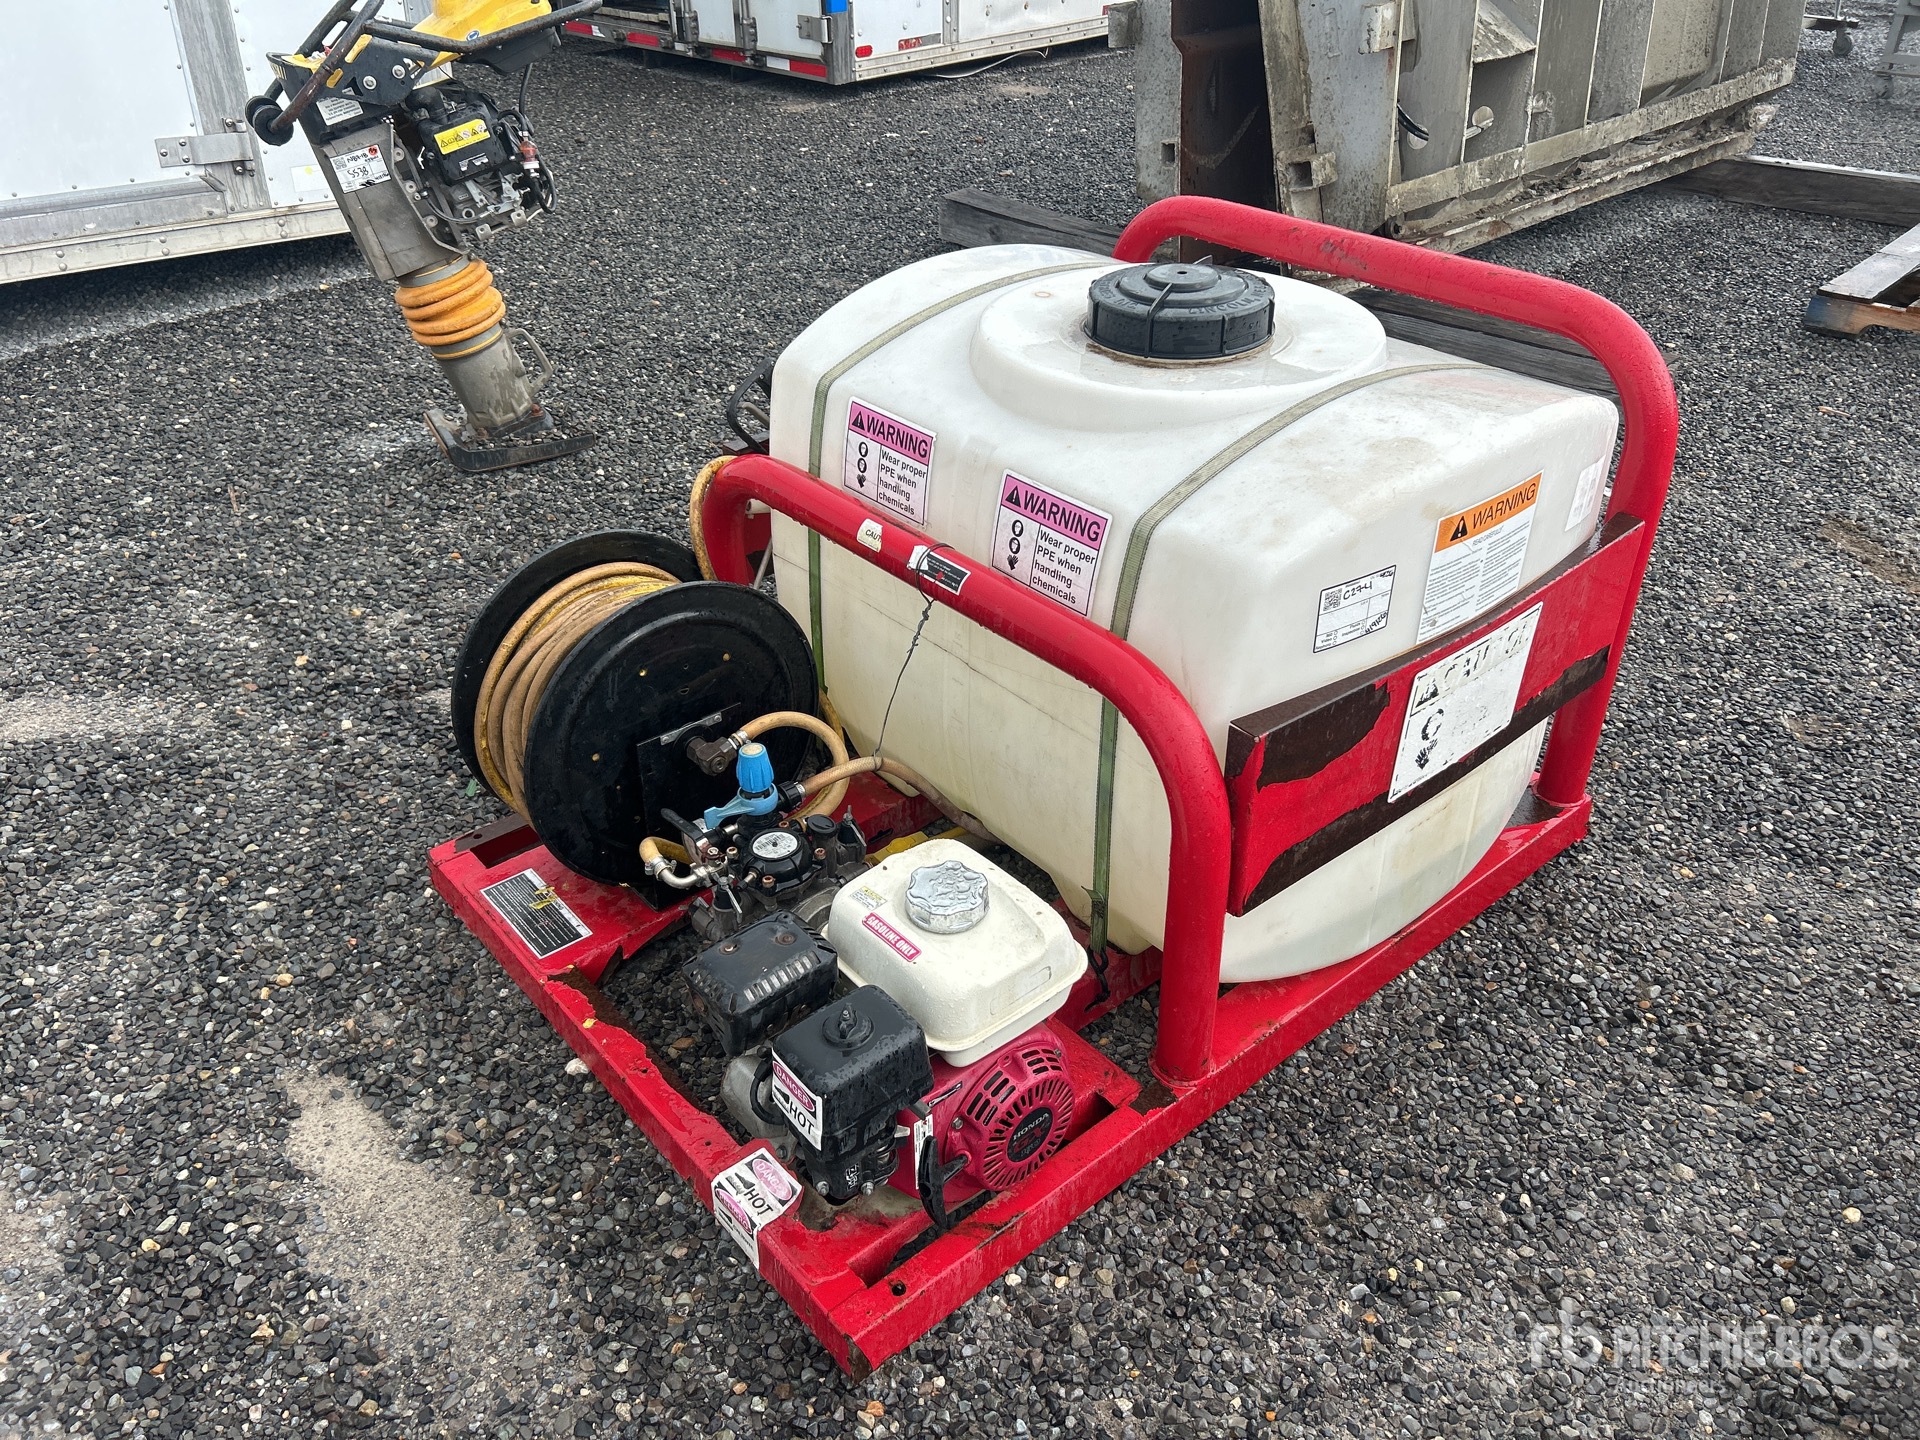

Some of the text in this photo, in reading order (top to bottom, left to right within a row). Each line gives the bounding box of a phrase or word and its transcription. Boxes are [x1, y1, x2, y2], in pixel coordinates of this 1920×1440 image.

[866, 414, 928, 459] WARNING
[880, 463, 917, 489] PPE when
[881, 449, 927, 479] Wear proper
[878, 490, 915, 515] chemicals
[879, 477, 911, 501] handling
[1024, 490, 1101, 542] WARNING
[1472, 483, 1536, 530] WARNING
[1036, 545, 1081, 575] PPE when
[1039, 530, 1096, 565] Wear proper
[1034, 560, 1073, 589] handling
[1032, 575, 1077, 605] chemicals
[867, 916, 916, 957] GASOLINE ONLY
[775, 1066, 810, 1107] DANGER
[789, 1100, 815, 1136] HOT
[1013, 1112, 1050, 1141] HONDA
[744, 1188, 775, 1216] HOT
